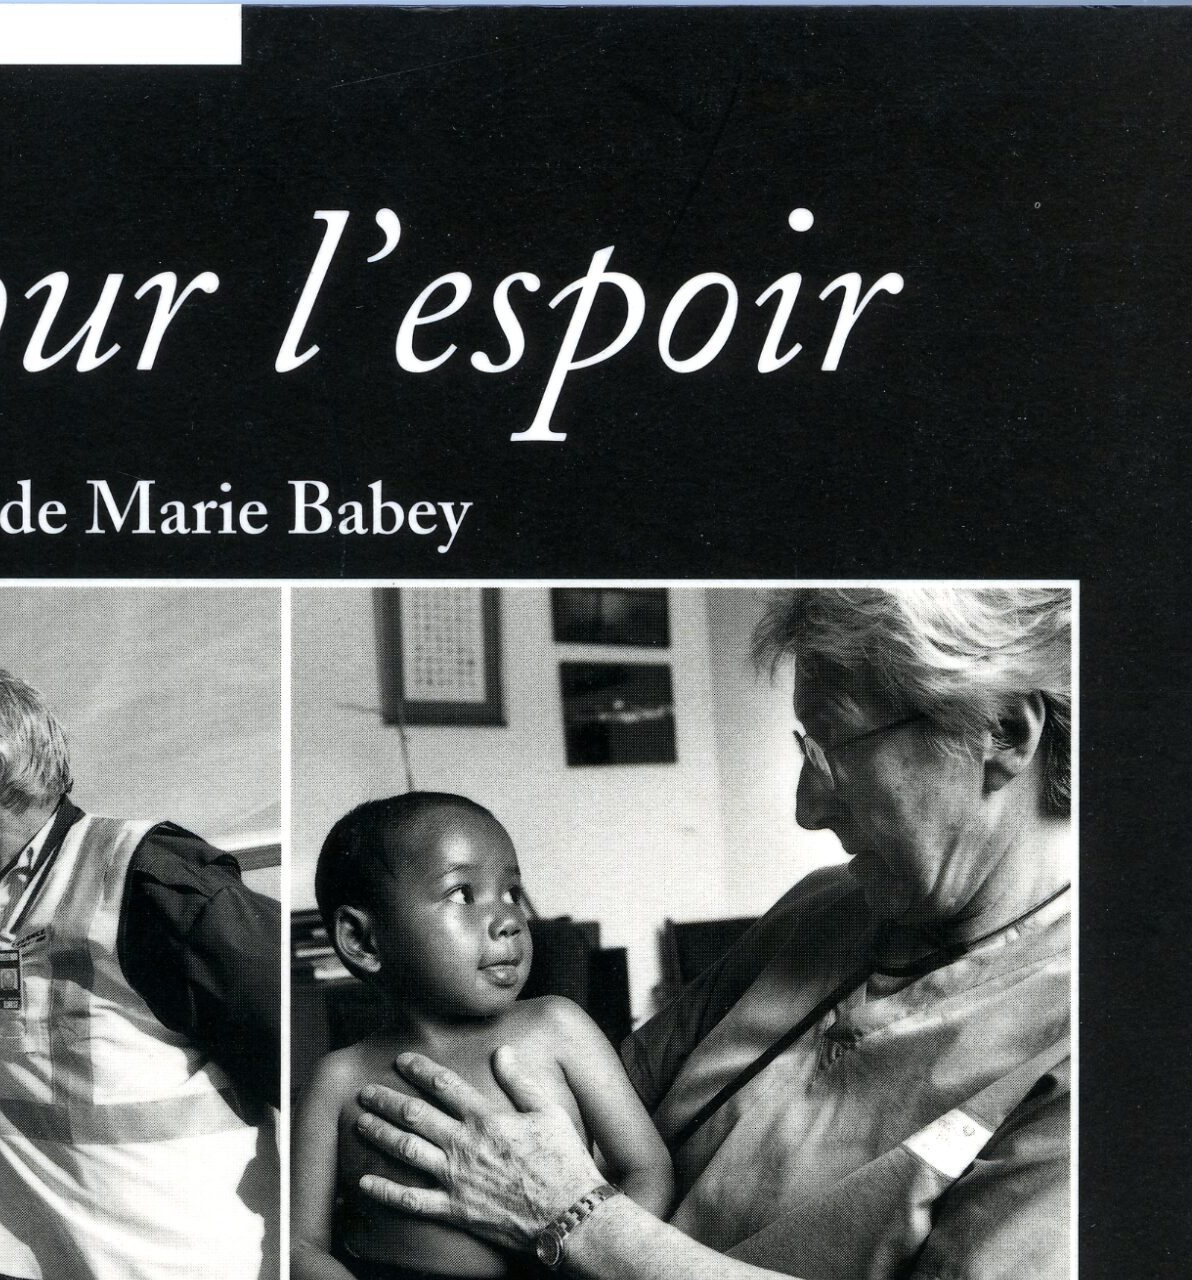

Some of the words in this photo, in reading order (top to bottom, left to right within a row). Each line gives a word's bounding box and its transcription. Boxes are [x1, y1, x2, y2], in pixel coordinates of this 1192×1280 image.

[0, 480, 66, 534] de
[86, 480, 267, 534] Marie
[289, 480, 472, 553] Babey
